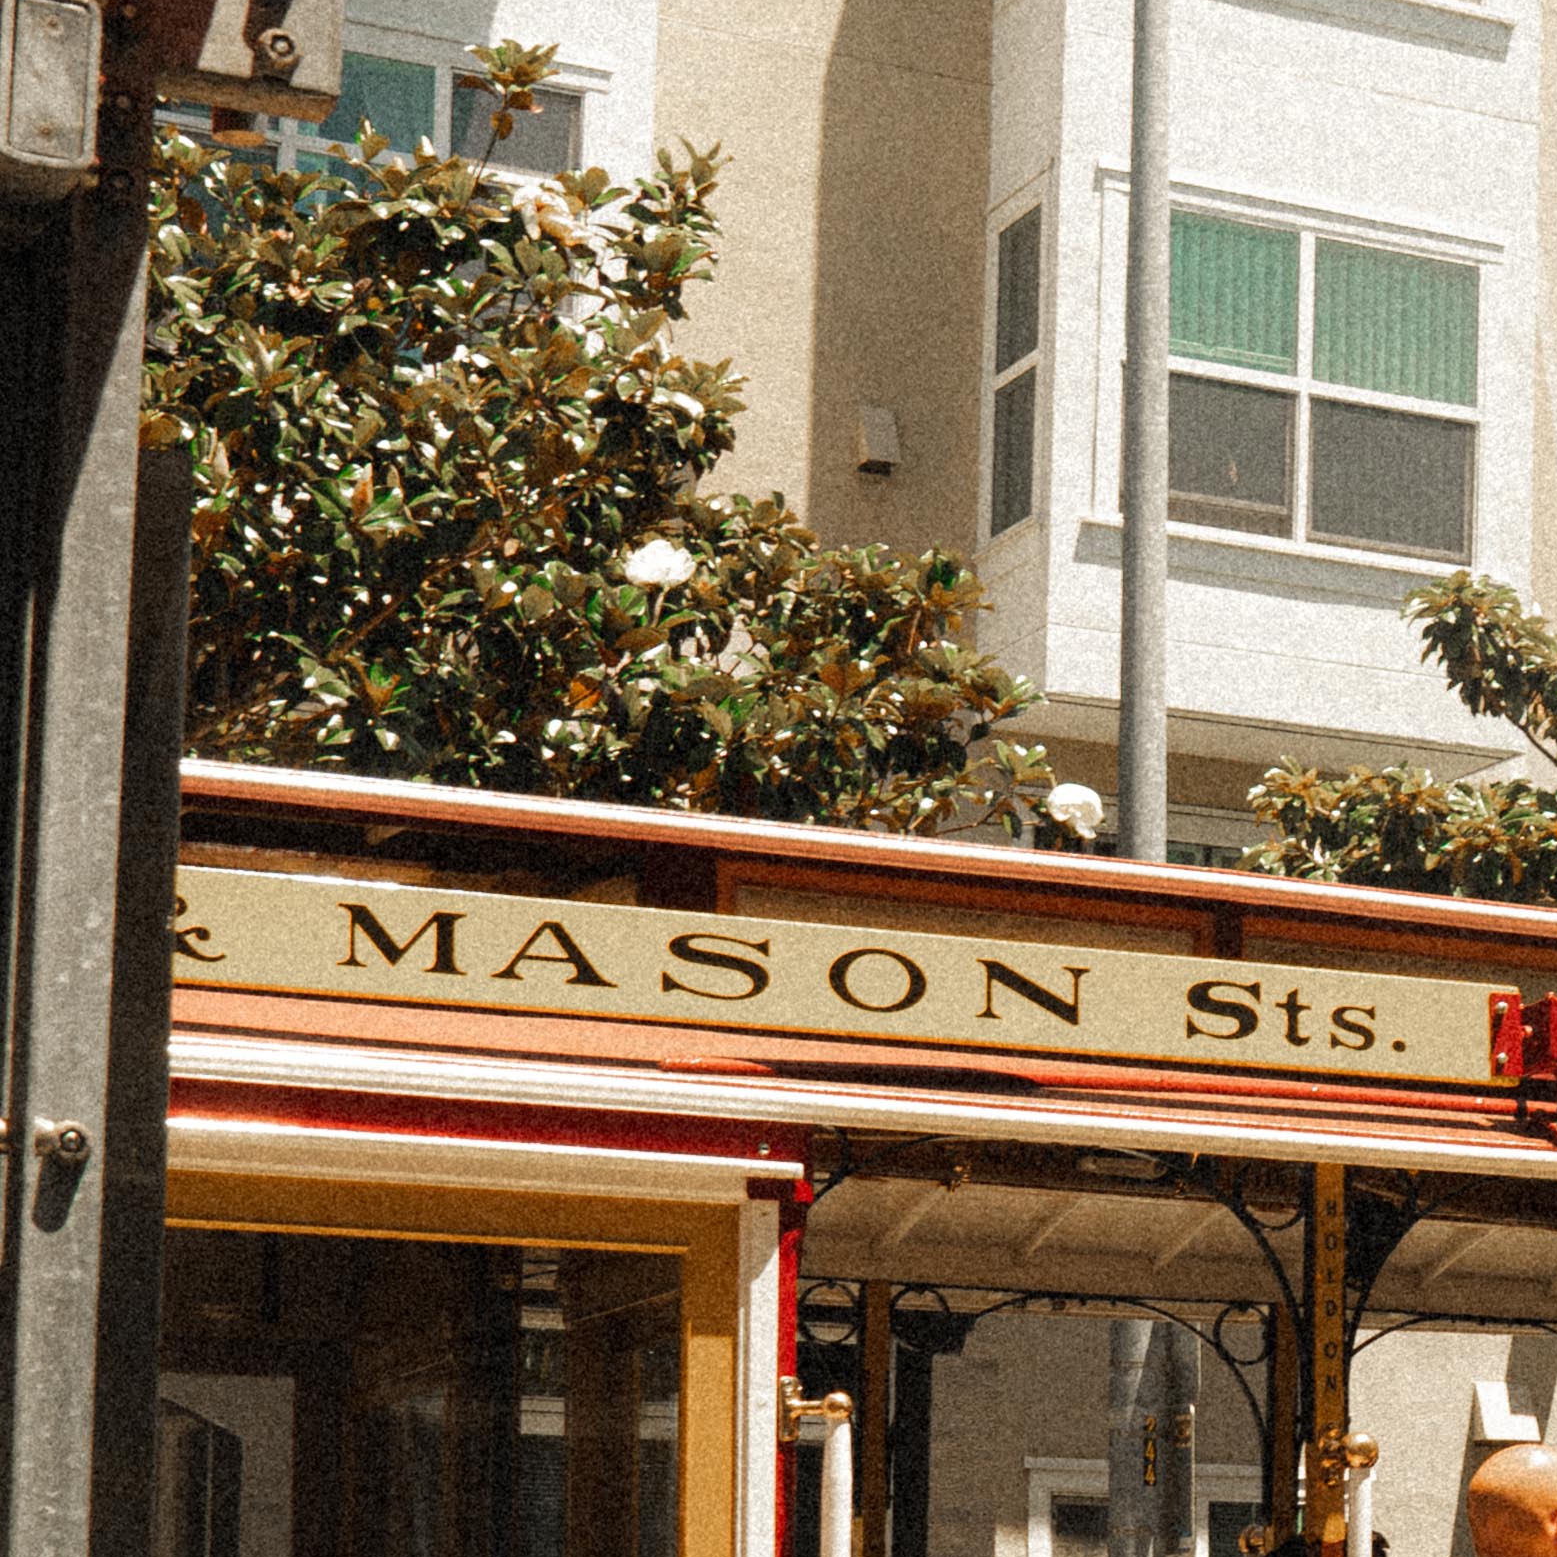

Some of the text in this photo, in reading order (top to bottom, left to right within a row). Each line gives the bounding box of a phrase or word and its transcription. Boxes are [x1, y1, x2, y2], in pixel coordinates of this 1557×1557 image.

[336, 902, 1091, 1027] MASON
[1186, 980, 1406, 1053] Sts.
[1324, 1200, 1339, 1392] HOLD ON
